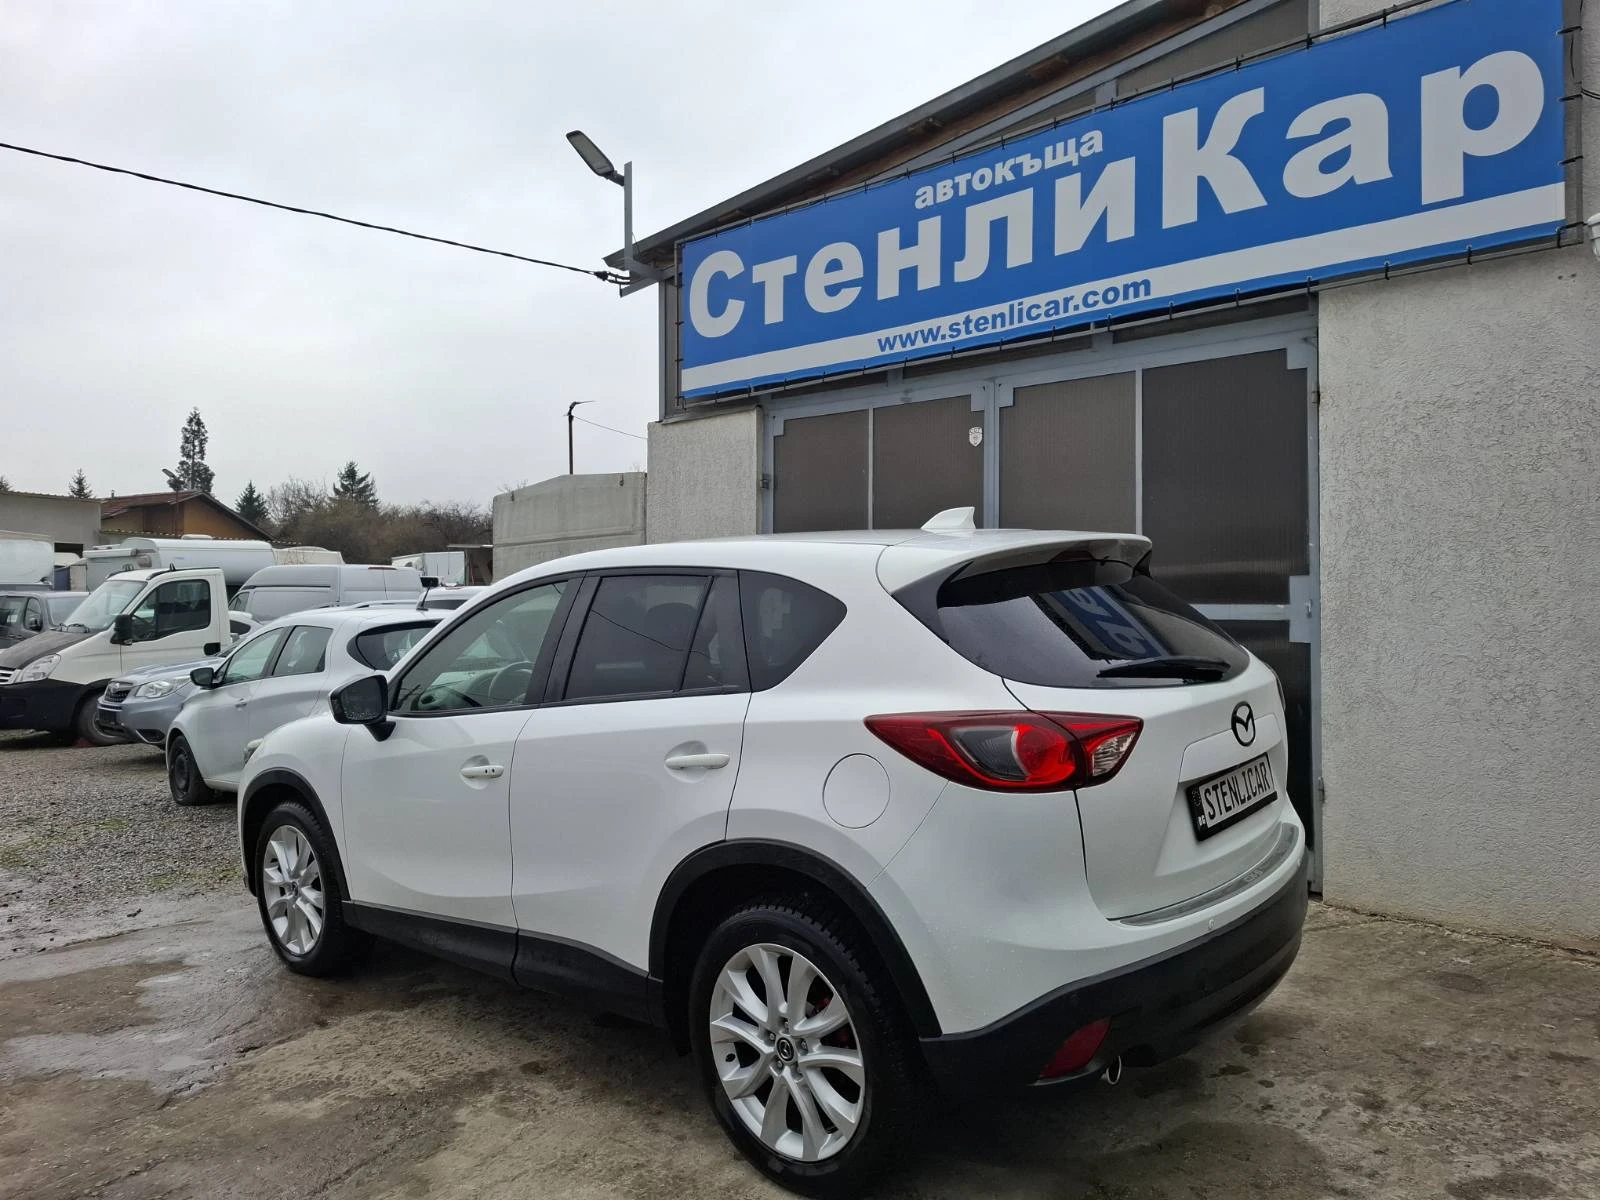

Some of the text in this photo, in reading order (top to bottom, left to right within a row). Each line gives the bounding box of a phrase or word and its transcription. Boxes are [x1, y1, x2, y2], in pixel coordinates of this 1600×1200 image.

[689, 50, 1544, 339] СтенлиКар
[915, 130, 1104, 210] автокъща
[877, 278, 1152, 354] www.stenlicar.com
[1204, 761, 1271, 820] STENLICAR
